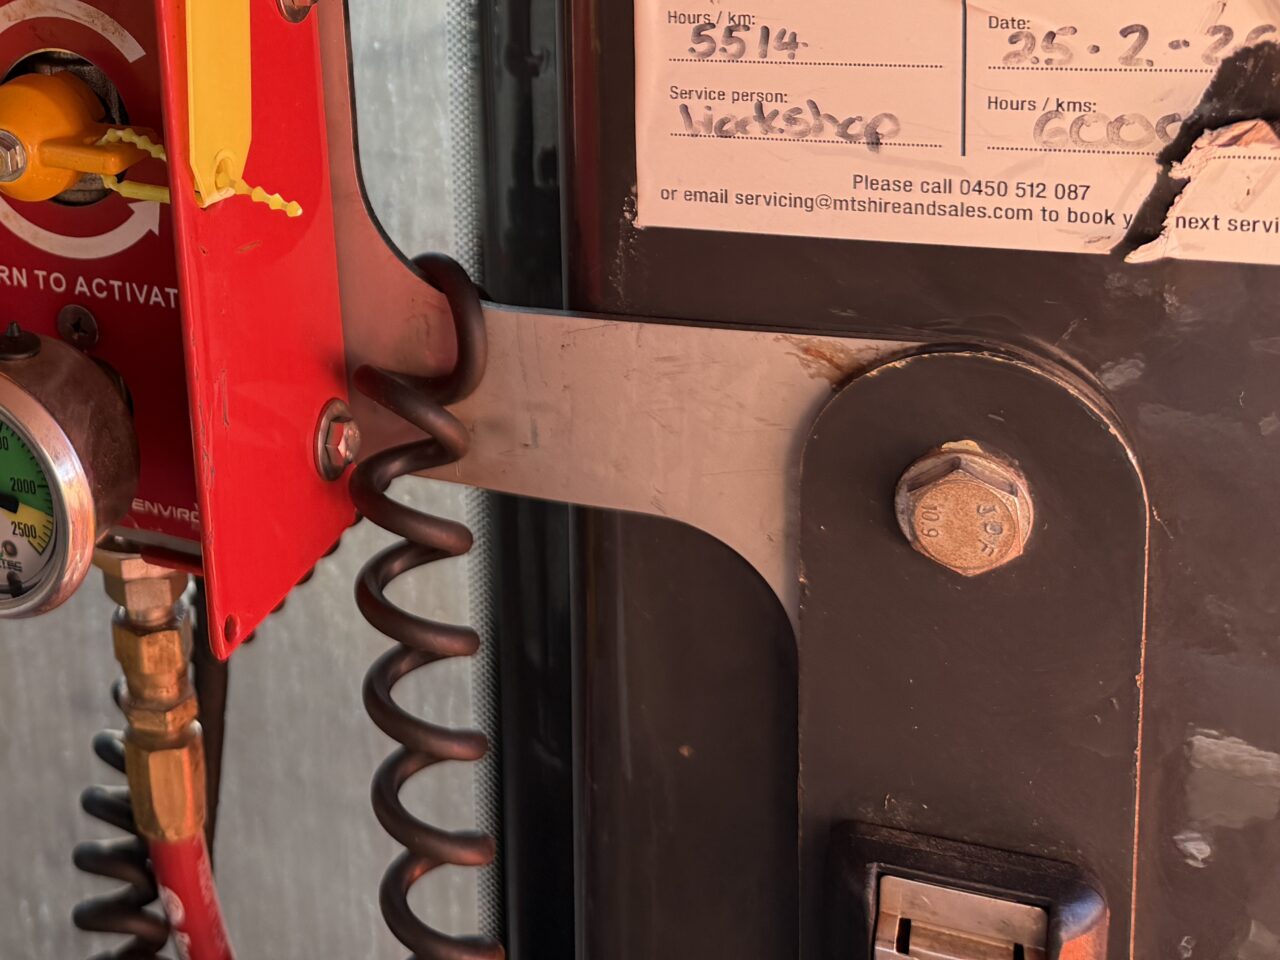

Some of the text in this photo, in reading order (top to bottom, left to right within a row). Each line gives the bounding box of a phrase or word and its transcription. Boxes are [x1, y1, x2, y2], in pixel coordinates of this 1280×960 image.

[667, 10, 756, 26] Hours / km:
[988, 15, 1030, 30] Date:
[669, 85, 788, 105] Service person:
[987, 95, 1097, 114] Hours / kms:
[852, 174, 1091, 201] Please call 0450 512 087
[660, 188, 676, 201] or
[683, 188, 729, 204] email
[735, 190, 1033, 221] servicing@mtshireandsales.com
[1041, 206, 1059, 222] to
[1067, 207, 1116, 226] book
[1175, 214, 1220, 231] next
[34, 270, 67, 294] TO
[74, 275, 178, 309] ACTIVAT
[10, 477, 37, 495] 2000
[11, 521, 37, 539] 2500
